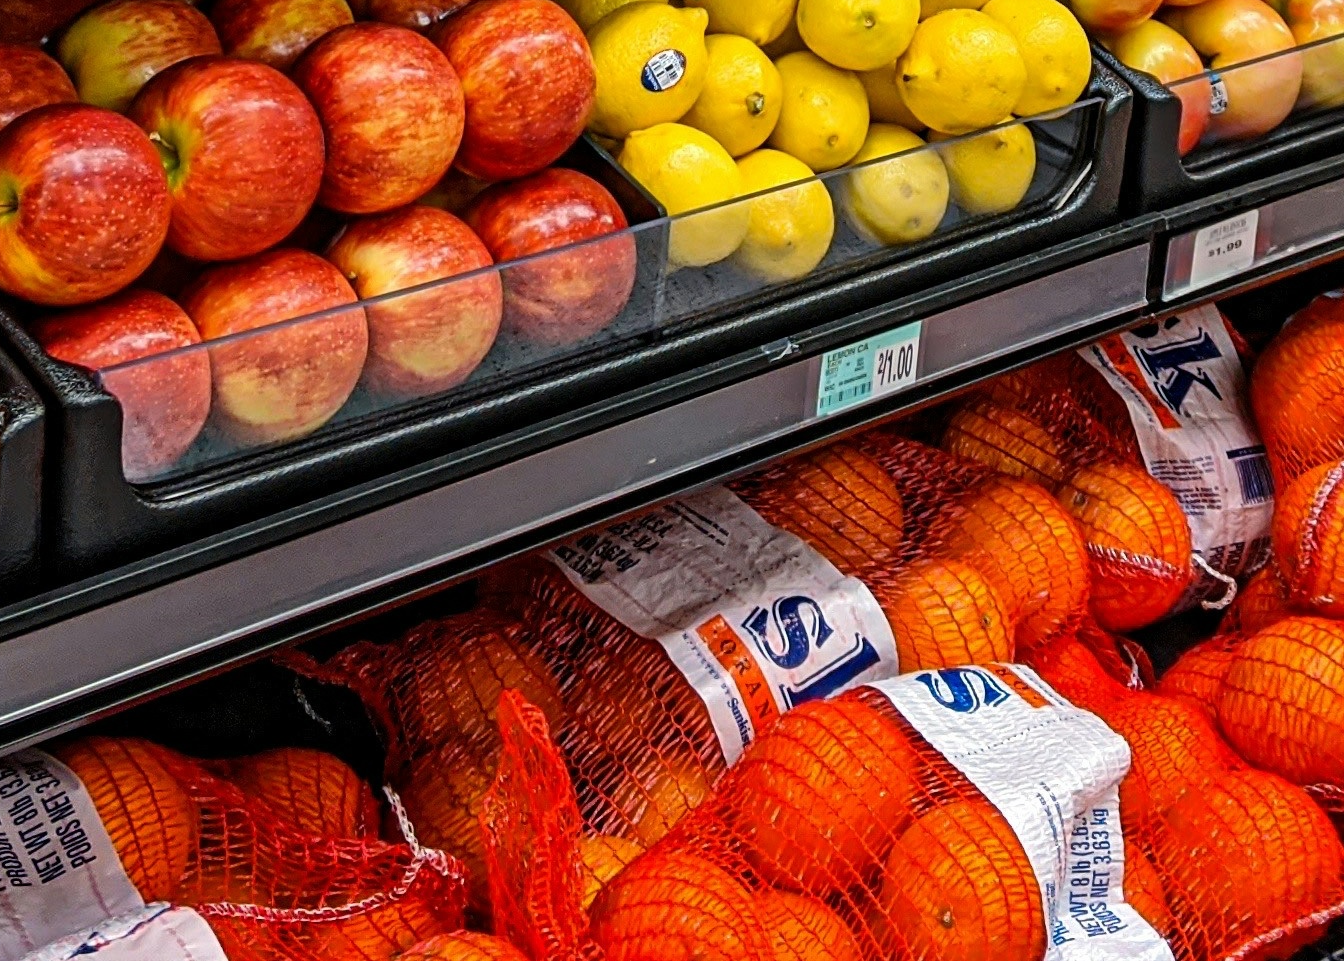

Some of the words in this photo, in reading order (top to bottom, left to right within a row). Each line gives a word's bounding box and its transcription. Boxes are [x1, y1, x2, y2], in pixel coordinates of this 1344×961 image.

[826, 347, 856, 366] LEMON
[857, 342, 869, 353] CA
[877, 343, 914, 386] 2/1.00
[40, 790, 76, 825] NET
[1089, 807, 1109, 827] kg
[18, 822, 52, 855] WT
[55, 818, 98, 869] POIDS
[1091, 830, 1113, 866] 3.63
[31, 850, 67, 884] NET
[1070, 876, 1091, 888] 8
[1071, 860, 1092, 874] lb
[1090, 869, 1111, 899] NET
[1068, 890, 1089, 918] WT
[1088, 900, 1129, 935] POIDS
[1075, 916, 1108, 938] NET
